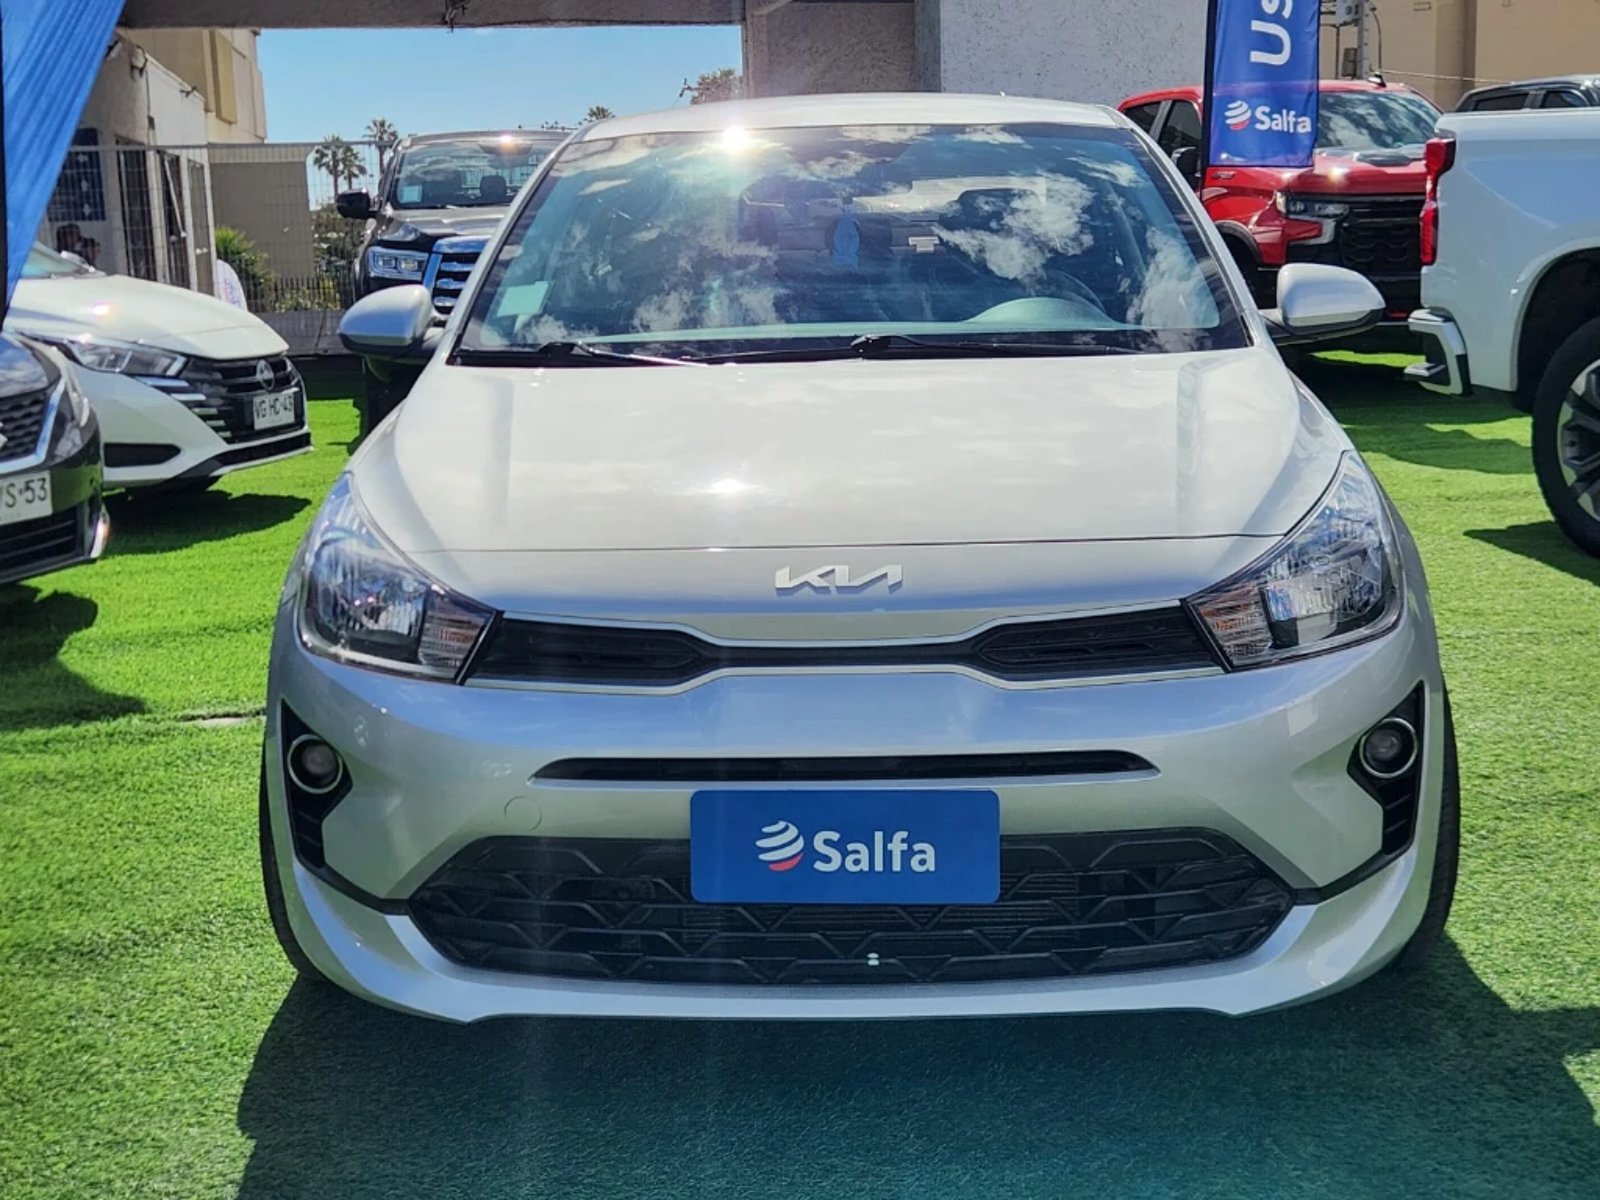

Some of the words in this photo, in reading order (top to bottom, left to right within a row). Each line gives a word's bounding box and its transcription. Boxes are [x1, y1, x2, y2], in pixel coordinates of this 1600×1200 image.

[1254, 105, 1312, 134] Salfa
[775, 565, 903, 595] KIA
[813, 830, 936, 872] Salfa
